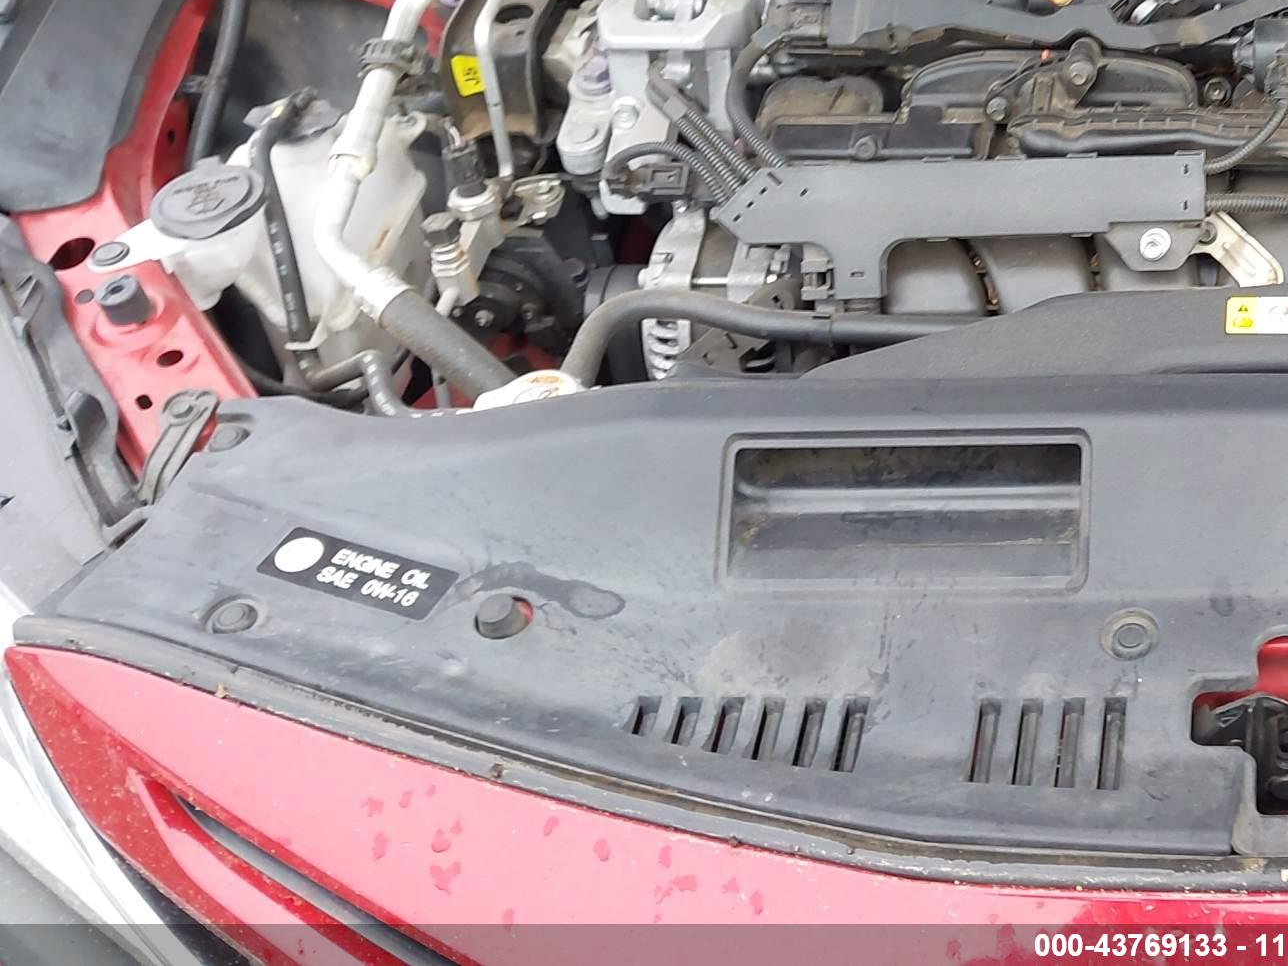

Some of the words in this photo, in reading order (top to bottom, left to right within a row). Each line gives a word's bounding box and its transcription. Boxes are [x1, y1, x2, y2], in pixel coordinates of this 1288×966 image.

[316, 566, 359, 589] SAE
[360, 578, 419, 607] 0W-16
[330, 547, 400, 579] ENGINE
[401, 568, 432, 590] OIL
